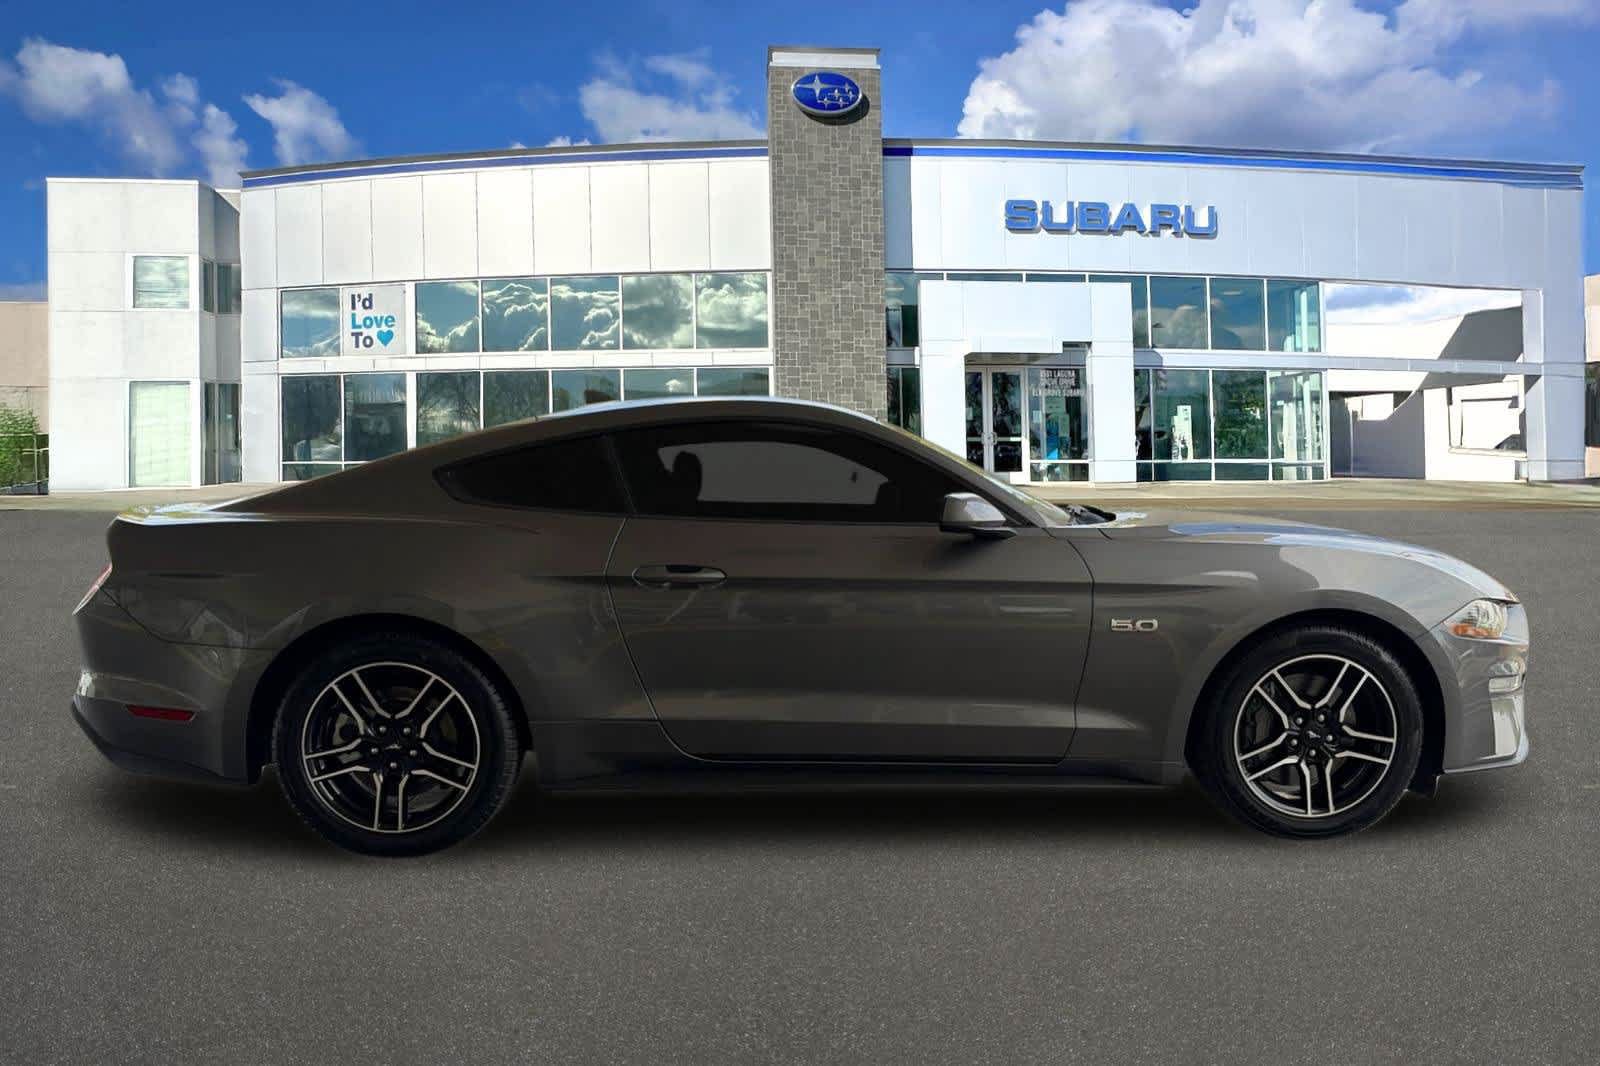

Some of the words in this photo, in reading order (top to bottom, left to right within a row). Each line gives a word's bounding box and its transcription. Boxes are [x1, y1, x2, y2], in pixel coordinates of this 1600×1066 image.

[1005, 199, 1217, 239] SUBARU
[351, 293, 373, 310] I'd
[351, 313, 396, 329] Love
[351, 331, 374, 348] To
[1111, 619, 1158, 631] 5.0
